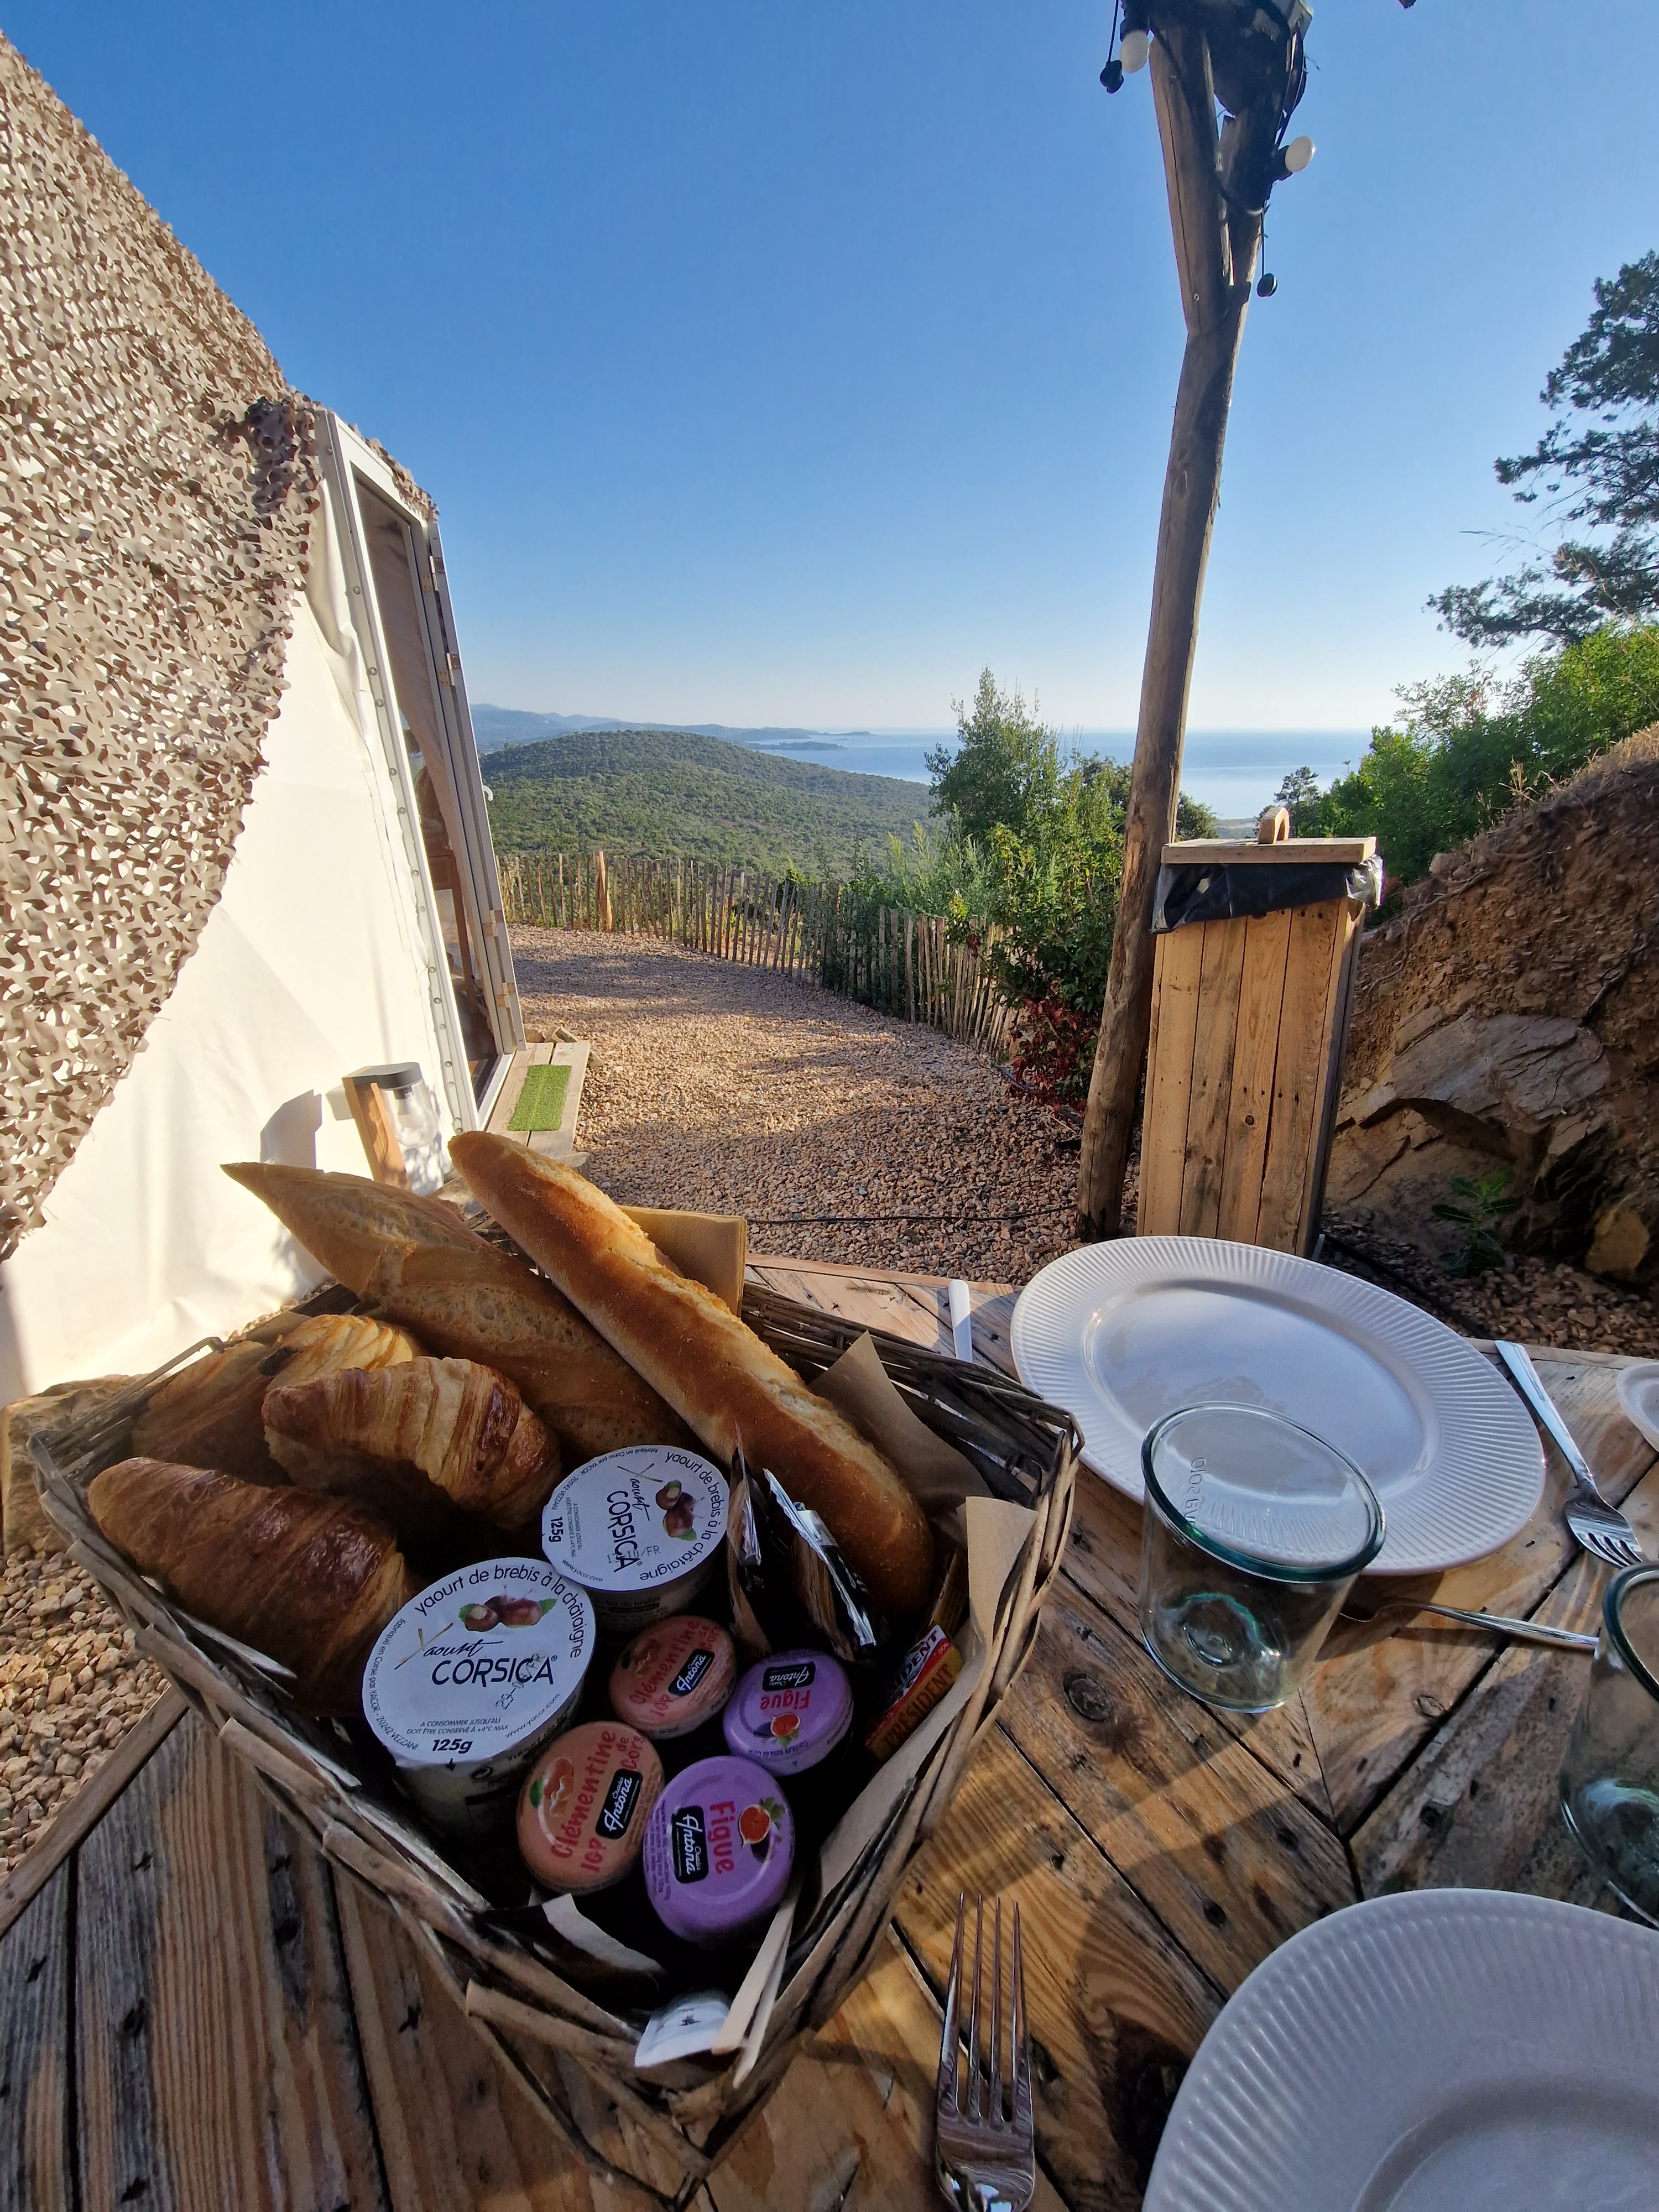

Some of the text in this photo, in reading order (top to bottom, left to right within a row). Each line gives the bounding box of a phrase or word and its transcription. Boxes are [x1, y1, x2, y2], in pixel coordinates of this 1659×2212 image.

[665, 1452, 702, 1473] yaourt
[700, 1471, 713, 1484] de
[708, 1483, 724, 1517] brebis
[549, 1516, 564, 1542] 125g
[701, 1530, 717, 1540] la
[640, 1542, 703, 1580] châtaigne
[415, 1576, 464, 1616] yaourt
[469, 1569, 489, 1585] de
[494, 1564, 540, 1582] brebis
[541, 1572, 552, 1587] à
[551, 1577, 566, 1595] la
[562, 1592, 585, 1658] châtaigne
[383, 1618, 406, 1645] fabriqué
[378, 1646, 386, 1655] en
[371, 1656, 383, 1676] Corse
[368, 1677, 377, 1688] par
[370, 1689, 380, 1713] YACOR
[760, 1689, 810, 1710] Figue
[377, 1715, 394, 1734] 20242
[505, 1694, 561, 1738] www.yacor.com
[392, 1731, 419, 1751] VEZZANI
[432, 1739, 473, 1754] 125g
[617, 1737, 628, 1751] de
[551, 1730, 615, 1859] Clémentine
[604, 1777, 633, 1832] Antona
[676, 1814, 703, 1875] Antona
[707, 1801, 735, 1875] Figue
[581, 1837, 604, 1872] IGP
